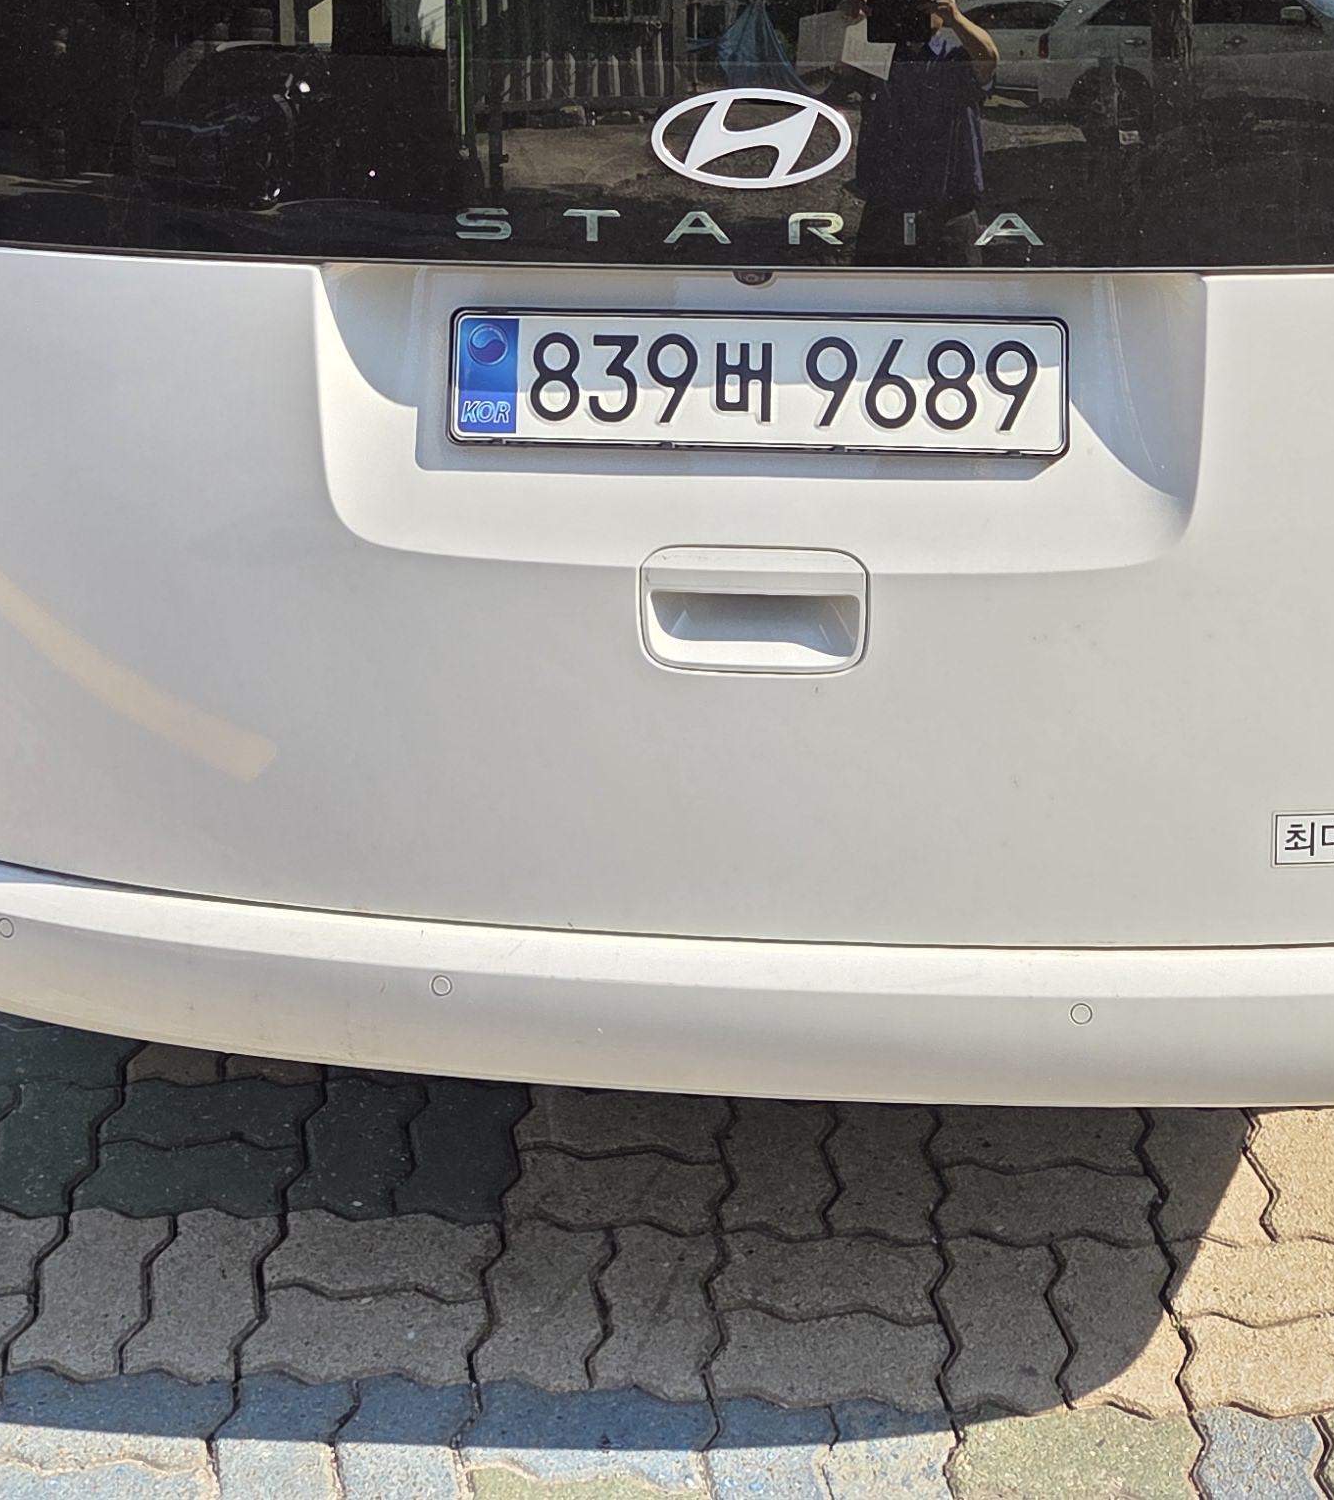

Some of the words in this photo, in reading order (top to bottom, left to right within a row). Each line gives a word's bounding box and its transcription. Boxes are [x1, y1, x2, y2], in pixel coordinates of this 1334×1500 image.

[454, 205, 1045, 248] STARIA
[529, 331, 774, 424] 839버
[804, 335, 1040, 433] 9689
[460, 400, 511, 424] KOR
